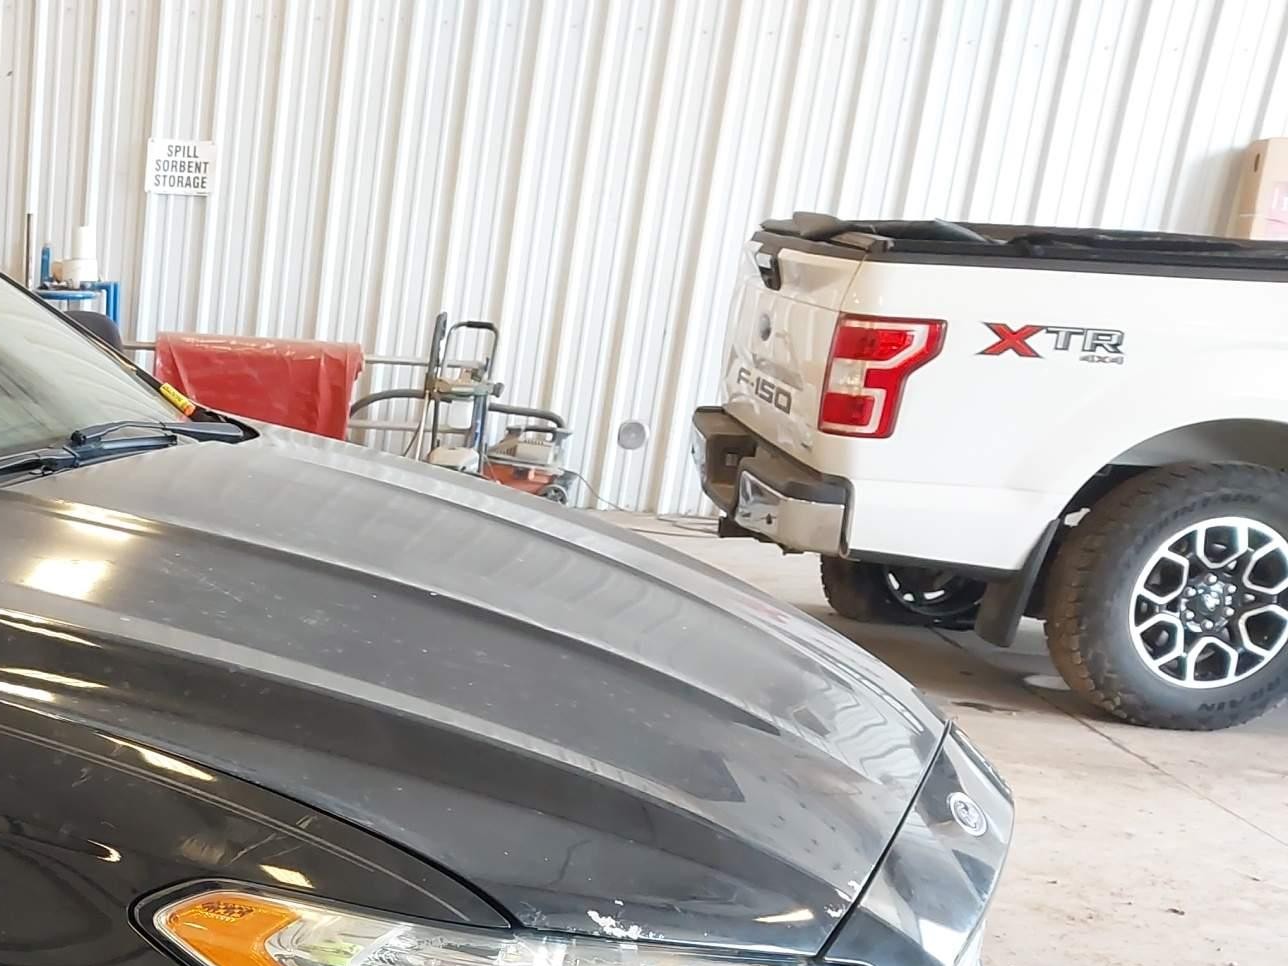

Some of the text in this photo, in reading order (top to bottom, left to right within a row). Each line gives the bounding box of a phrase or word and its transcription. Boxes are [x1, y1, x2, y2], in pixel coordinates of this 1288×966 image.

[167, 144, 199, 159] SPILL
[154, 159, 209, 174] SORBENT
[154, 174, 208, 189] STORAGE
[975, 322, 1125, 359] XTR
[737, 366, 792, 415] F-150
